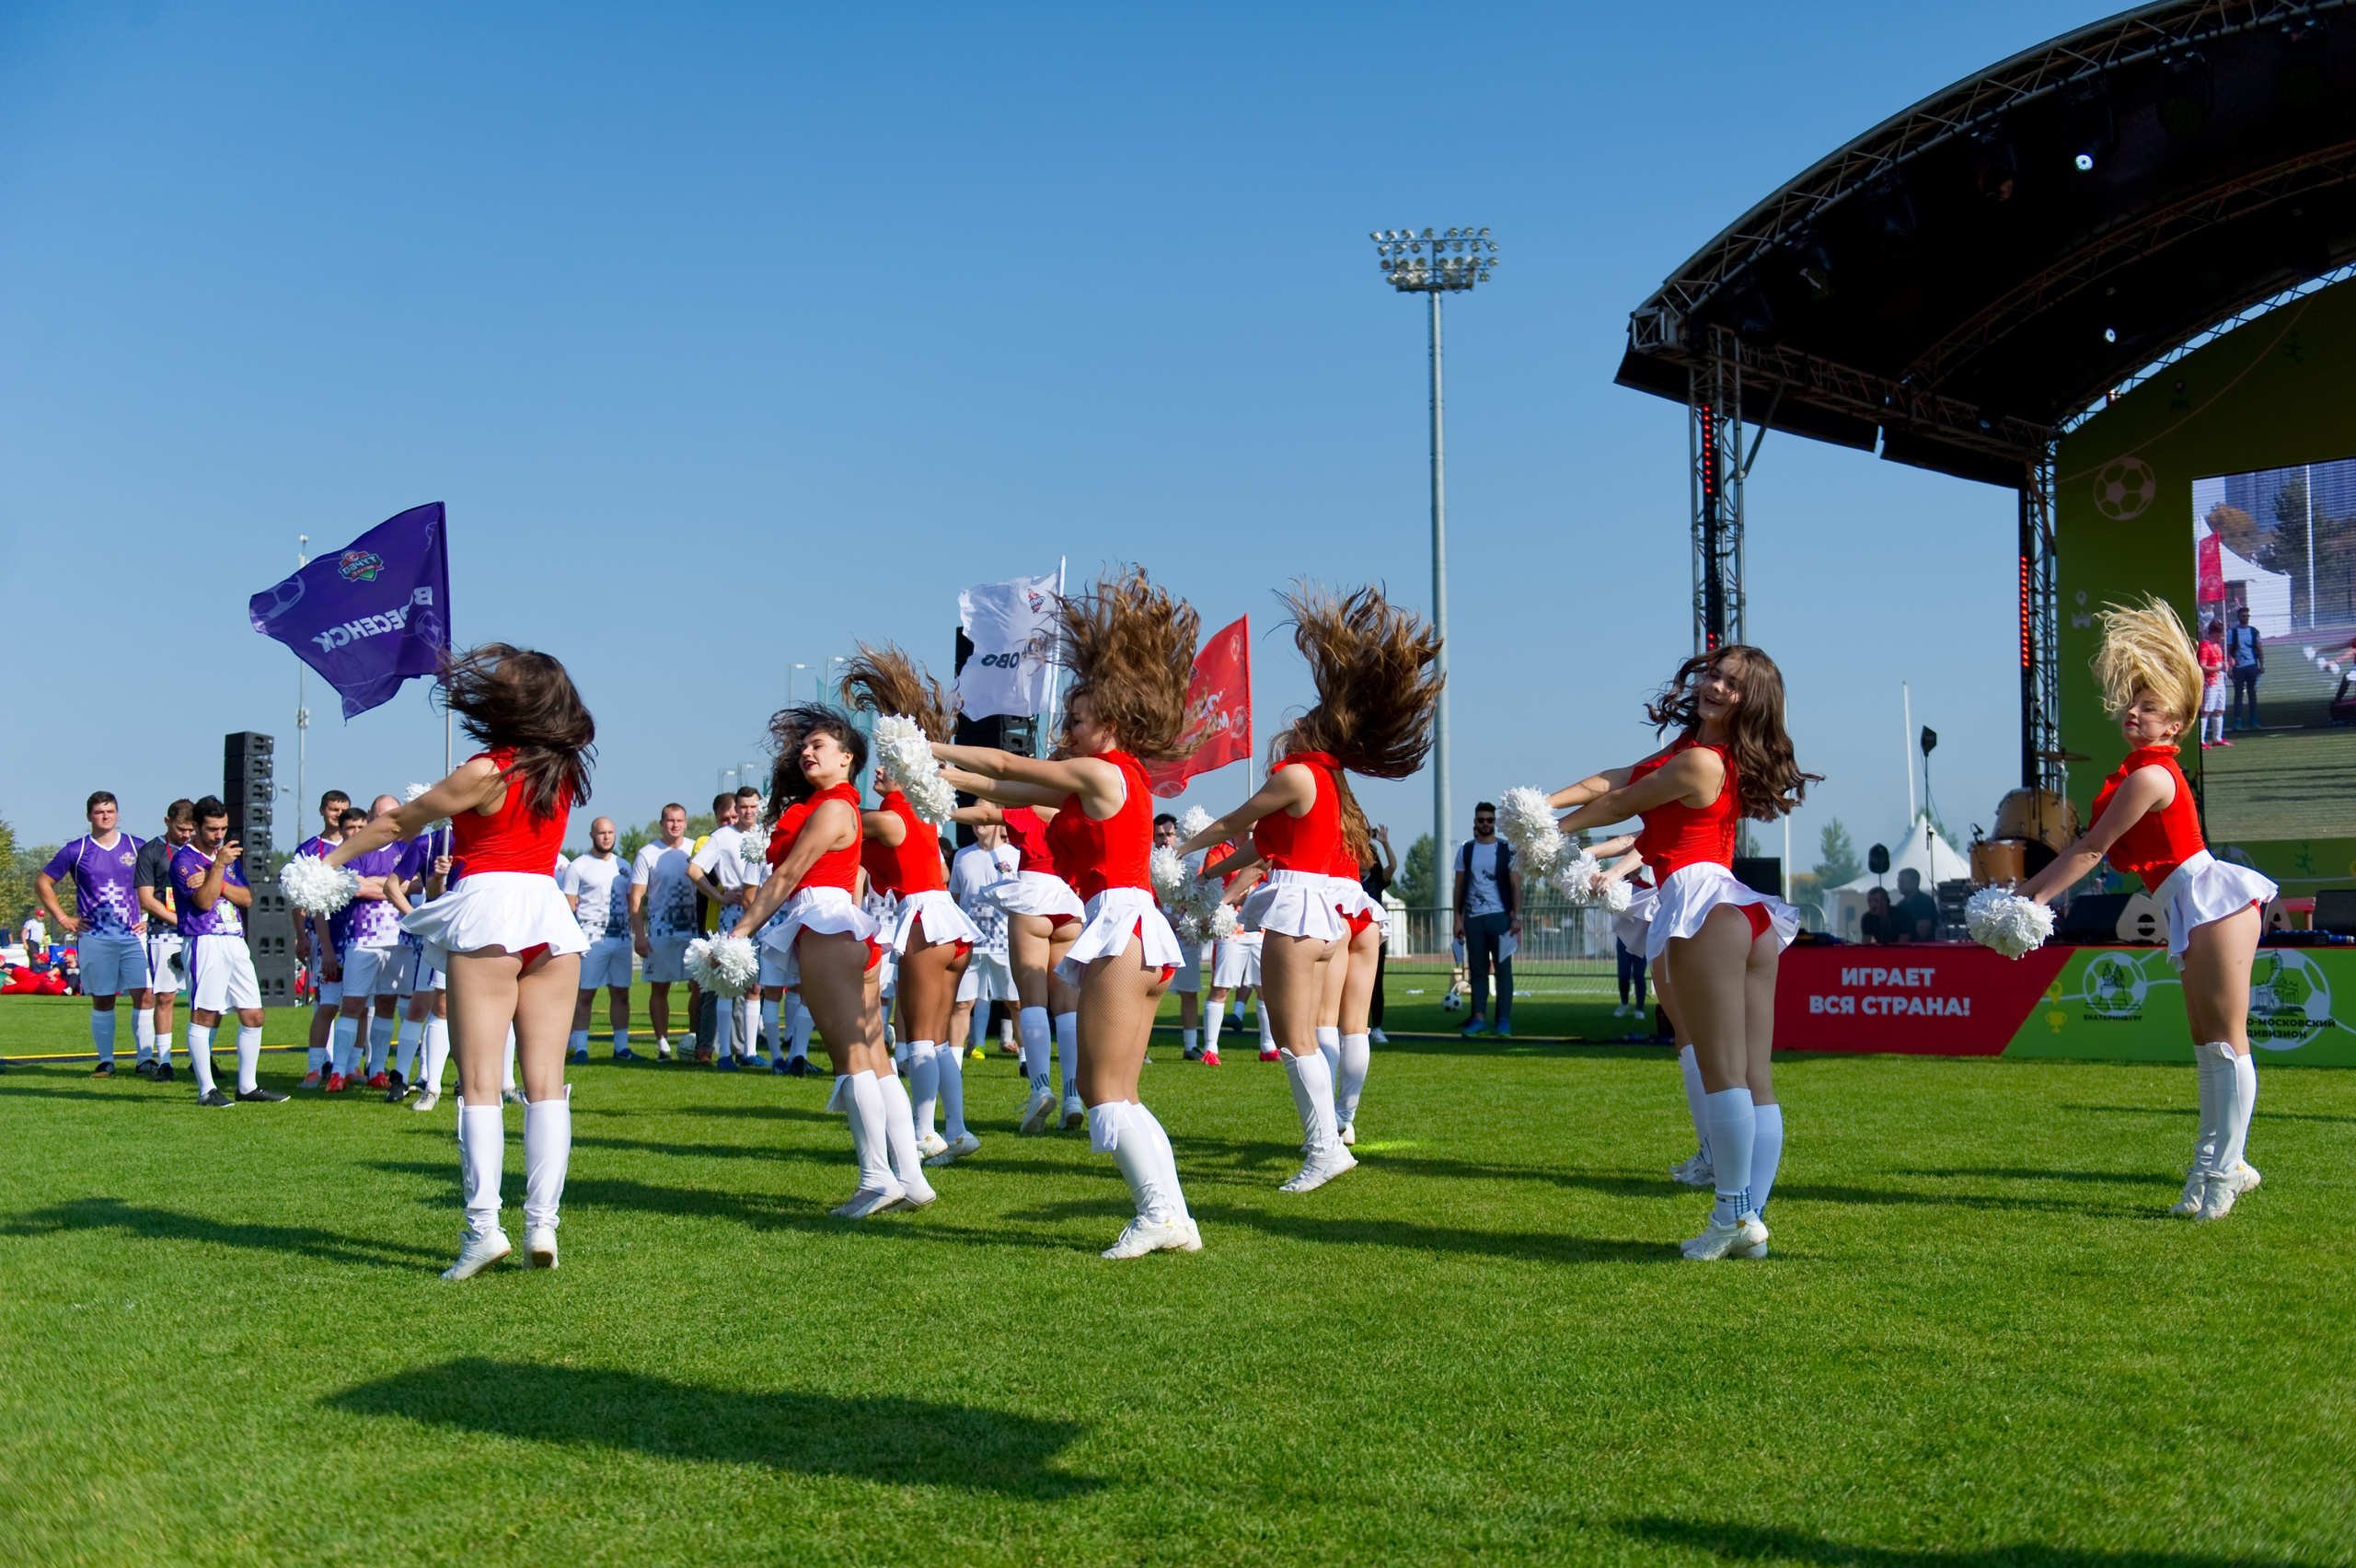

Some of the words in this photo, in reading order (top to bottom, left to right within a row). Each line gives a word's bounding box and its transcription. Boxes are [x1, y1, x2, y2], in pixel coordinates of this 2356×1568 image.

[1842, 967, 1935, 986] ИГРАЕТ
[1809, 995, 1855, 1014] ВСЯ
[1861, 996, 1970, 1016] СТРАНА!
[2246, 1018, 2336, 1028] О-МОСКОВСКИЙ
[2246, 1029, 2307, 1039] ДИВИЗИОН
